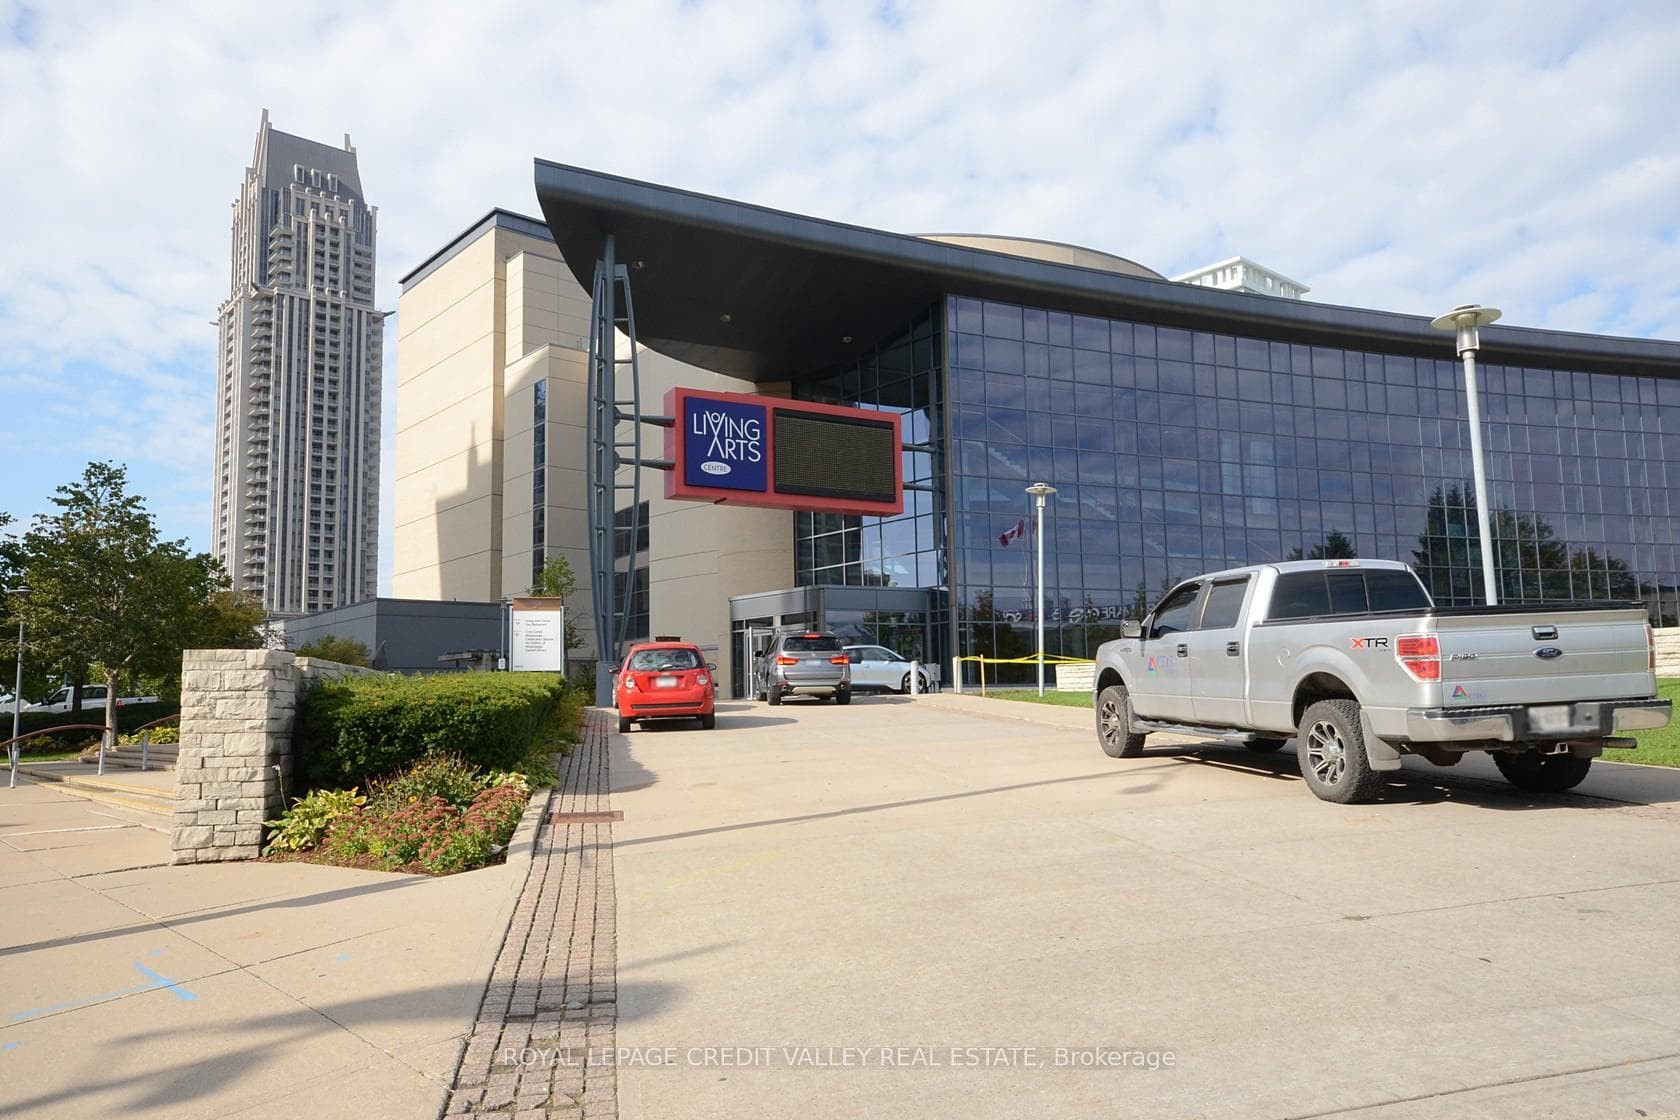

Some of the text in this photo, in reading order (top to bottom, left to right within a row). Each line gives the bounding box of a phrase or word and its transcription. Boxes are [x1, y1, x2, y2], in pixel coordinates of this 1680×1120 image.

[693, 410, 760, 440] LIVING
[707, 437, 761, 462] ARTS
[703, 464, 728, 473] CENTRE
[1352, 637, 1389, 648] XTR
